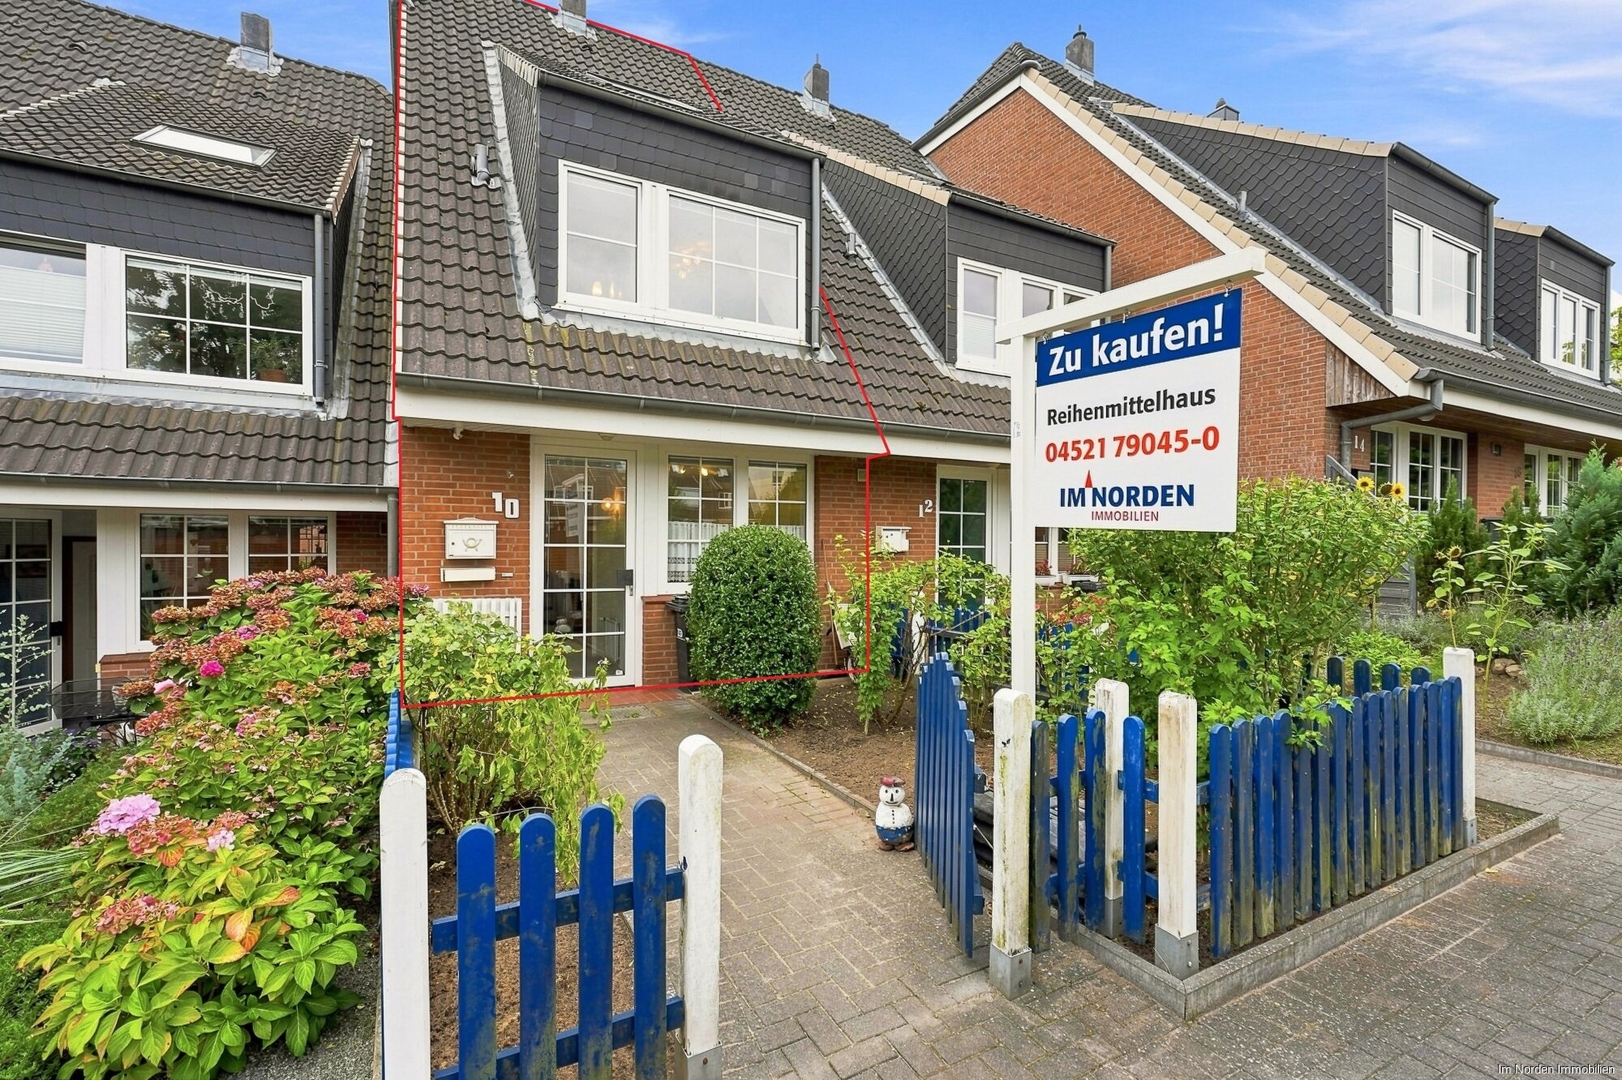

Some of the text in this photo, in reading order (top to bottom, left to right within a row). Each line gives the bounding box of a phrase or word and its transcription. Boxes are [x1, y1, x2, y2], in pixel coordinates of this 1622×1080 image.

[1049, 303, 1224, 376] Zu kaufen!
[1047, 388, 1216, 426] Reihenmittelhaus
[1045, 426, 1220, 463] 04521 79045-0
[1354, 435, 1365, 452] 14
[491, 491, 520, 519] 10
[918, 499, 934, 518] 12
[1060, 484, 1195, 508] IM NORDEN
[1091, 510, 1159, 522] IMMOBILIEN
